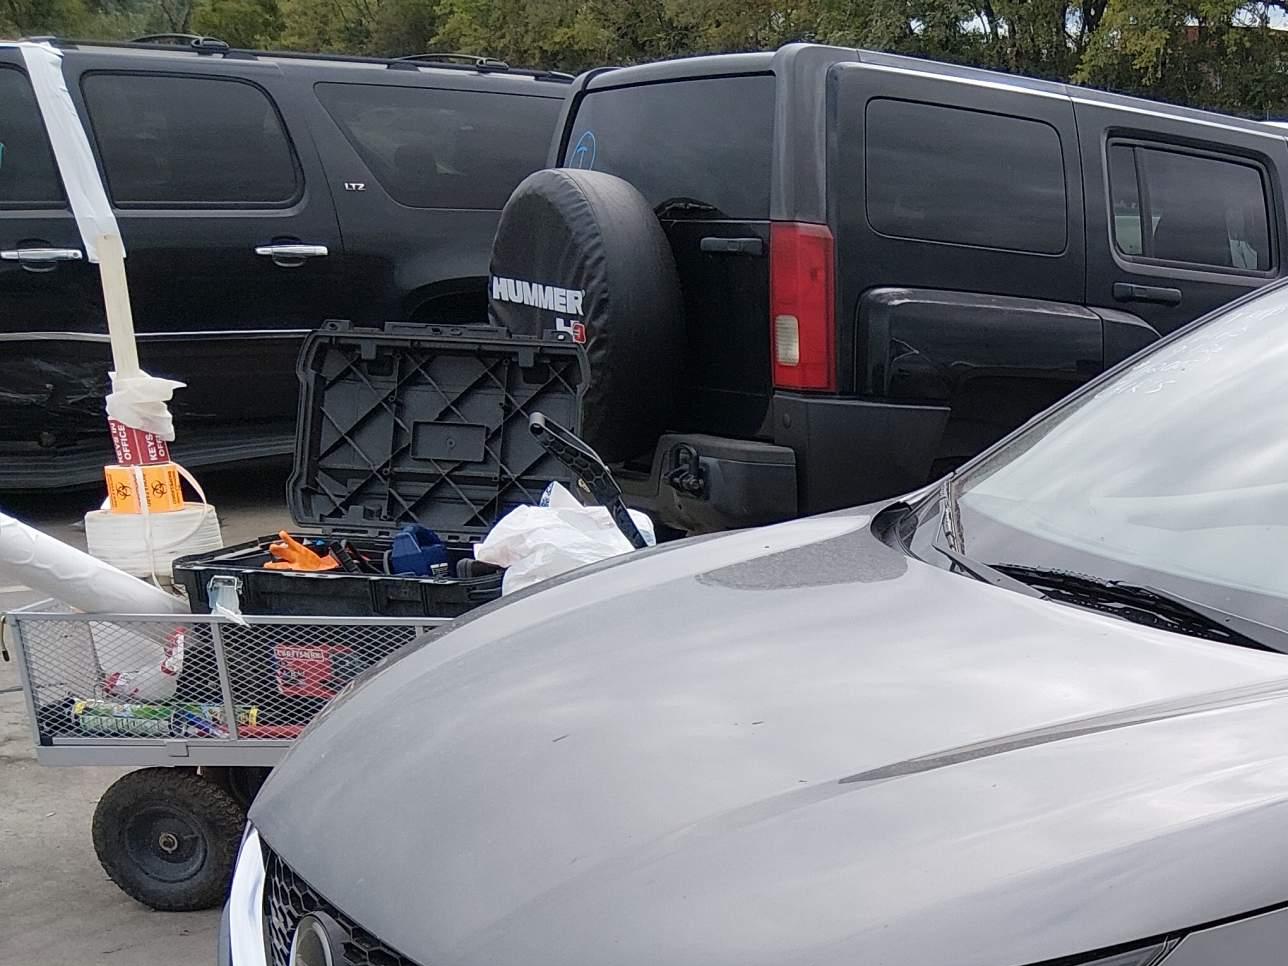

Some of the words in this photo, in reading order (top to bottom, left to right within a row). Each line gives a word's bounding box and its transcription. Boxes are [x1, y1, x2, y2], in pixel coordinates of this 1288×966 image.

[344, 182, 366, 191] LTZ
[492, 276, 584, 316] HUMMER
[118, 424, 132, 461] OFFICE
[145, 432, 158, 461] KEYS
